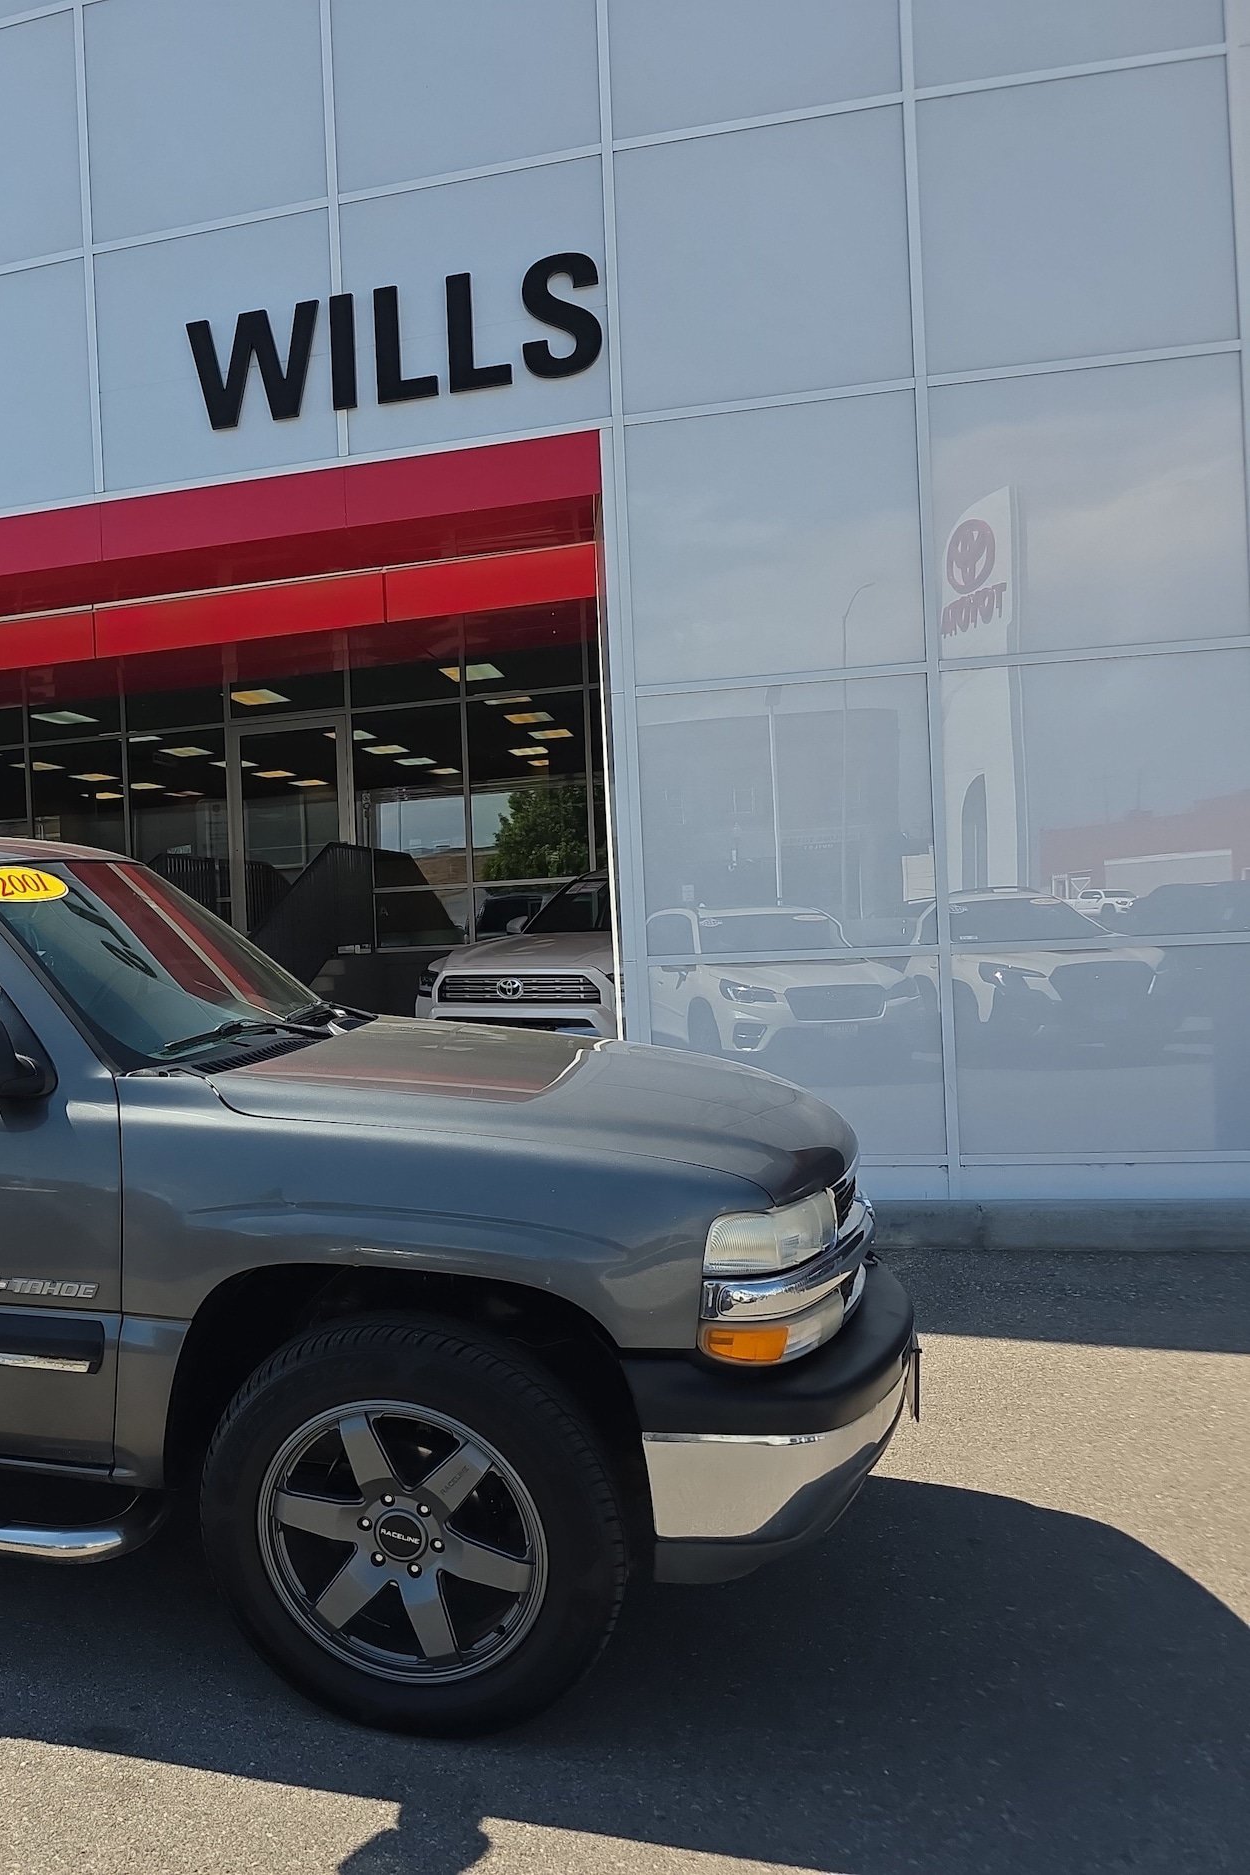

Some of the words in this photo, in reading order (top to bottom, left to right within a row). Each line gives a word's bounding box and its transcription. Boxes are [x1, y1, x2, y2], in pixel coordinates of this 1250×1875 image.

[185, 252, 603, 431] WILLS
[11, 1279, 97, 1298] TAHOE
[379, 1527, 421, 1546] RACELINE
